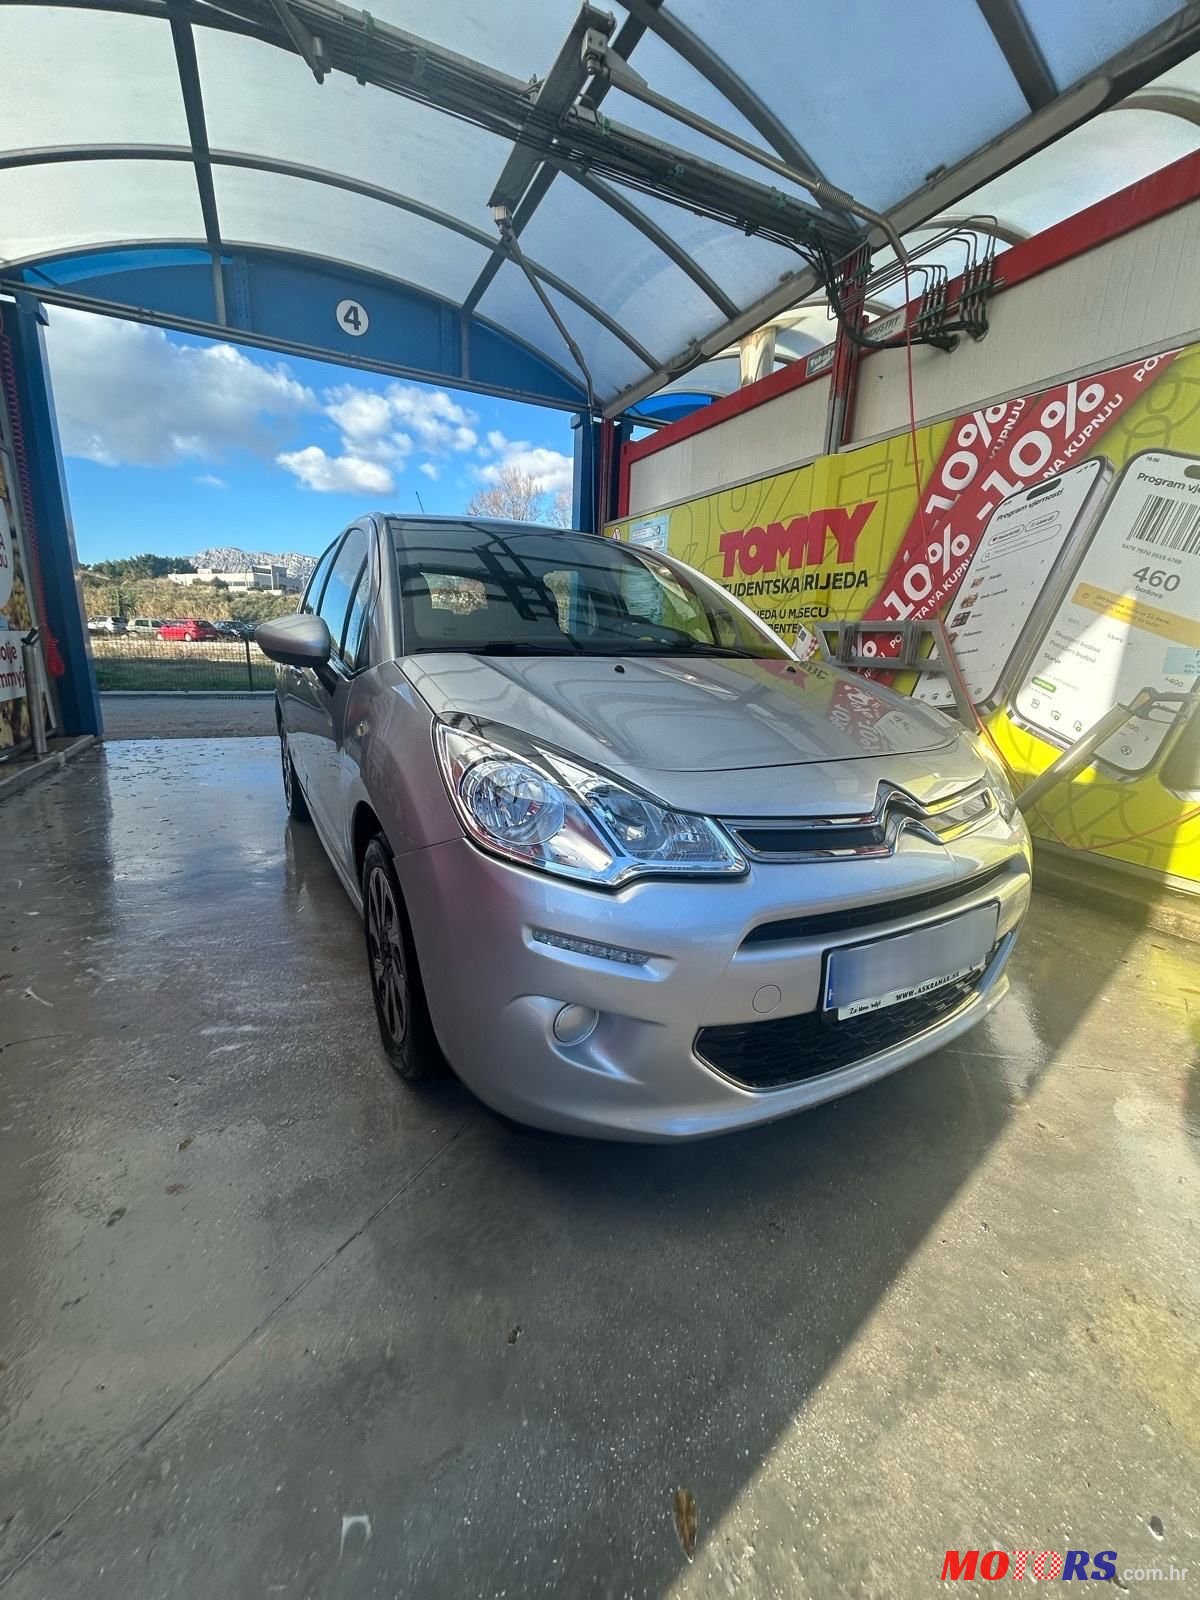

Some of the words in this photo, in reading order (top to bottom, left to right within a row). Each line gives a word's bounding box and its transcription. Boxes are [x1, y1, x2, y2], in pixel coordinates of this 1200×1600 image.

[343, 305, 362, 331] 4
[1042, 459, 1066, 481] NA
[1063, 393, 1124, 458] KUPNJU
[976, 381, 1105, 521] -10%
[1137, 472, 1186, 491] Program
[721, 576, 800, 598] TUDENTSKA
[1133, 566, 1181, 592] 460
[1135, 585, 1164, 599] bodova
